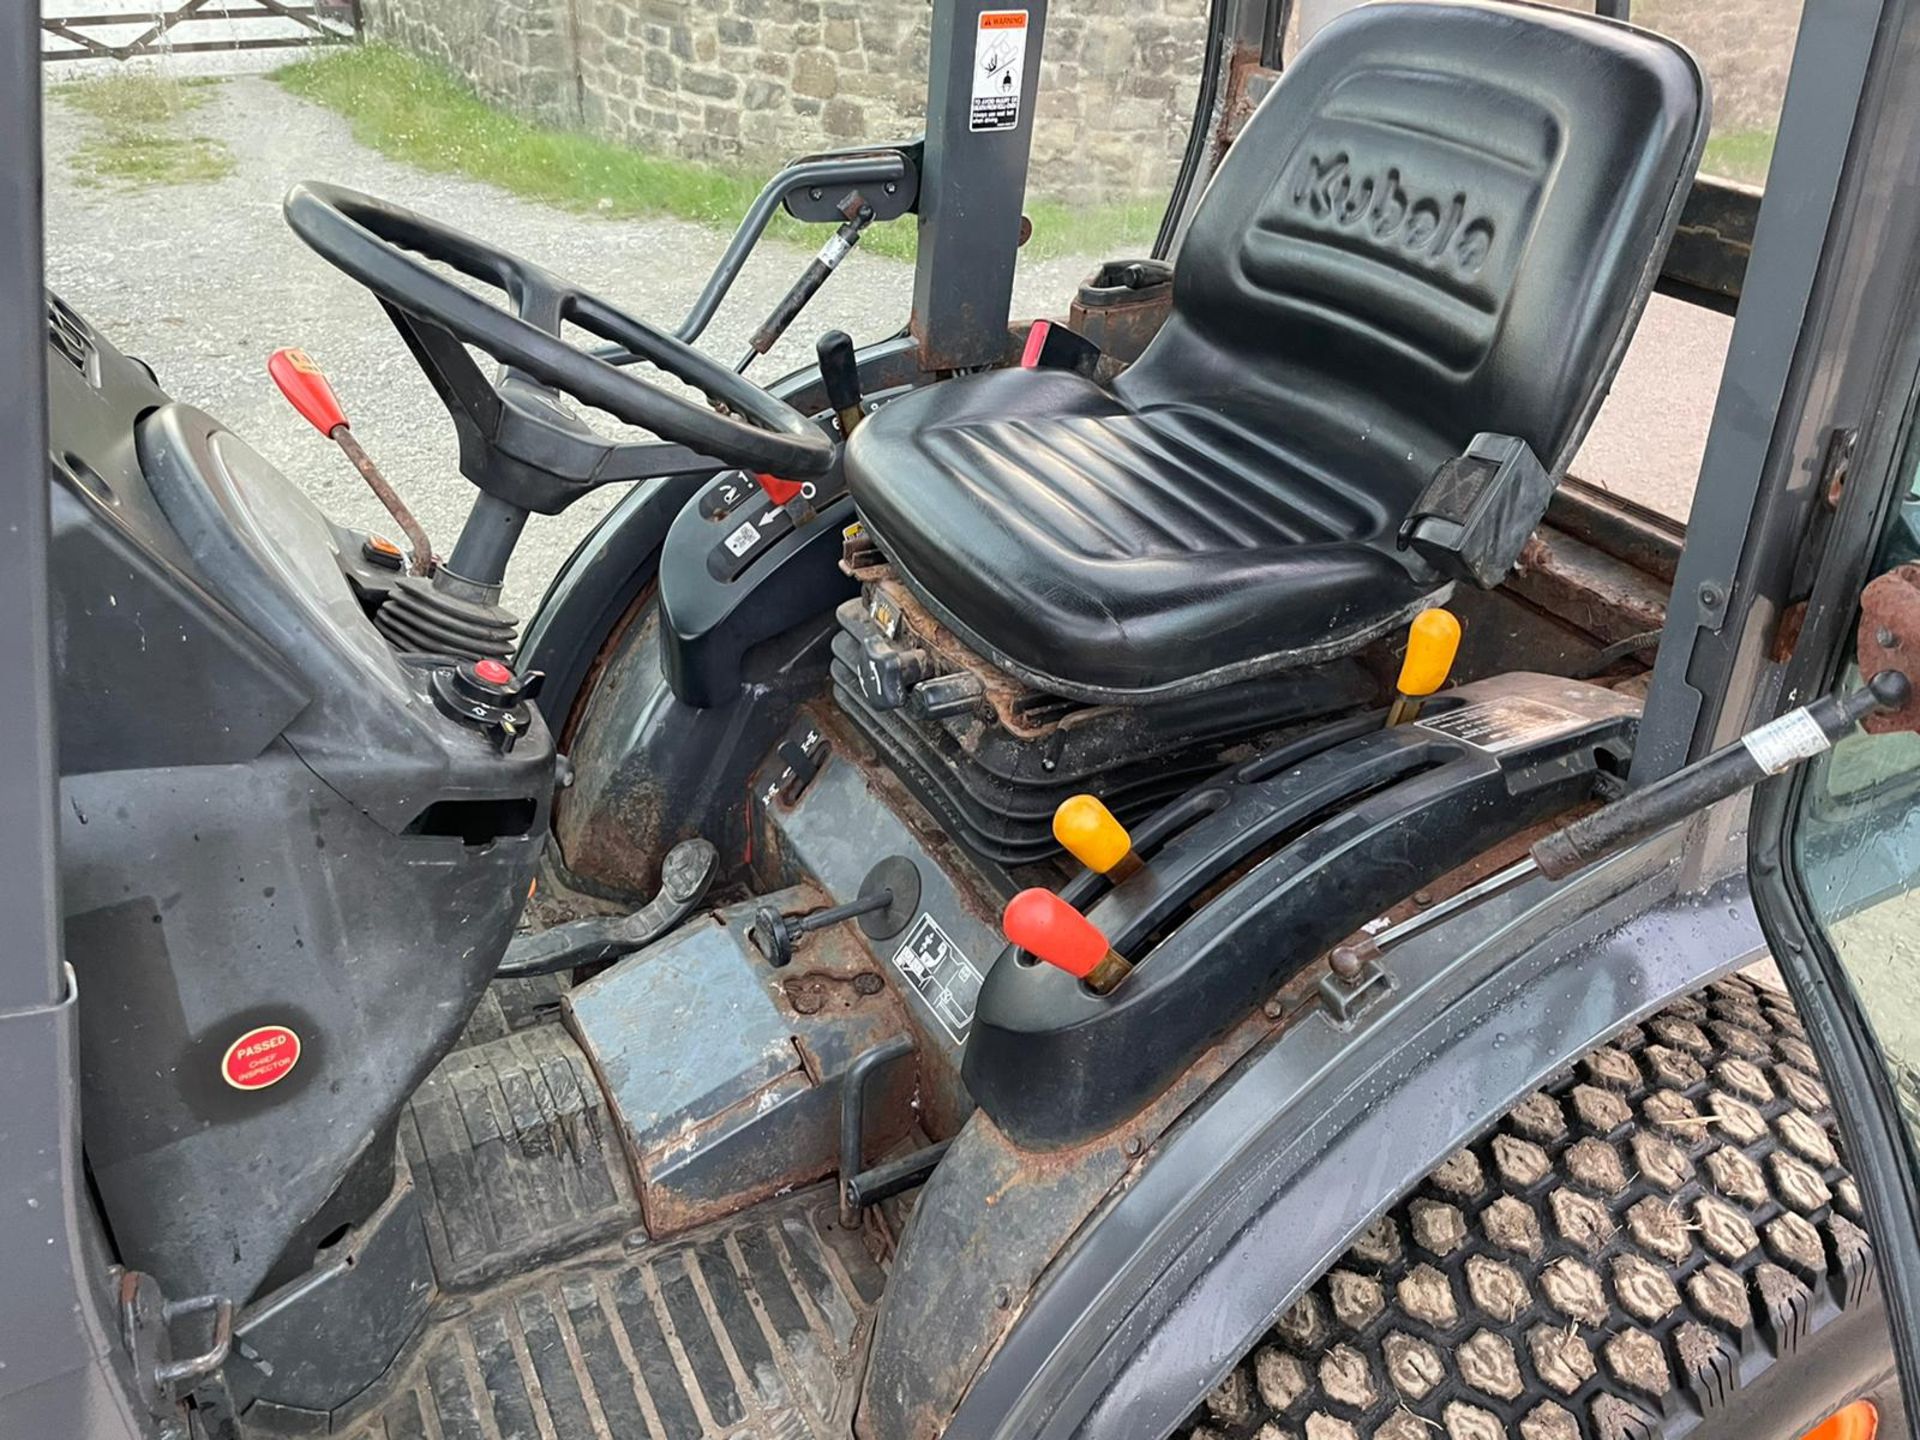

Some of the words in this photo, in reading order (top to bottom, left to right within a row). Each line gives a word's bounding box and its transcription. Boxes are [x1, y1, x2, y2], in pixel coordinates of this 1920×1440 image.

[993, 16, 1023, 25] WARNING
[1292, 150, 1496, 280] Kubota
[237, 1034, 286, 1060] PASSED
[238, 1057, 291, 1082] INSPECTOR
[249, 1053, 277, 1069] CHIEF
